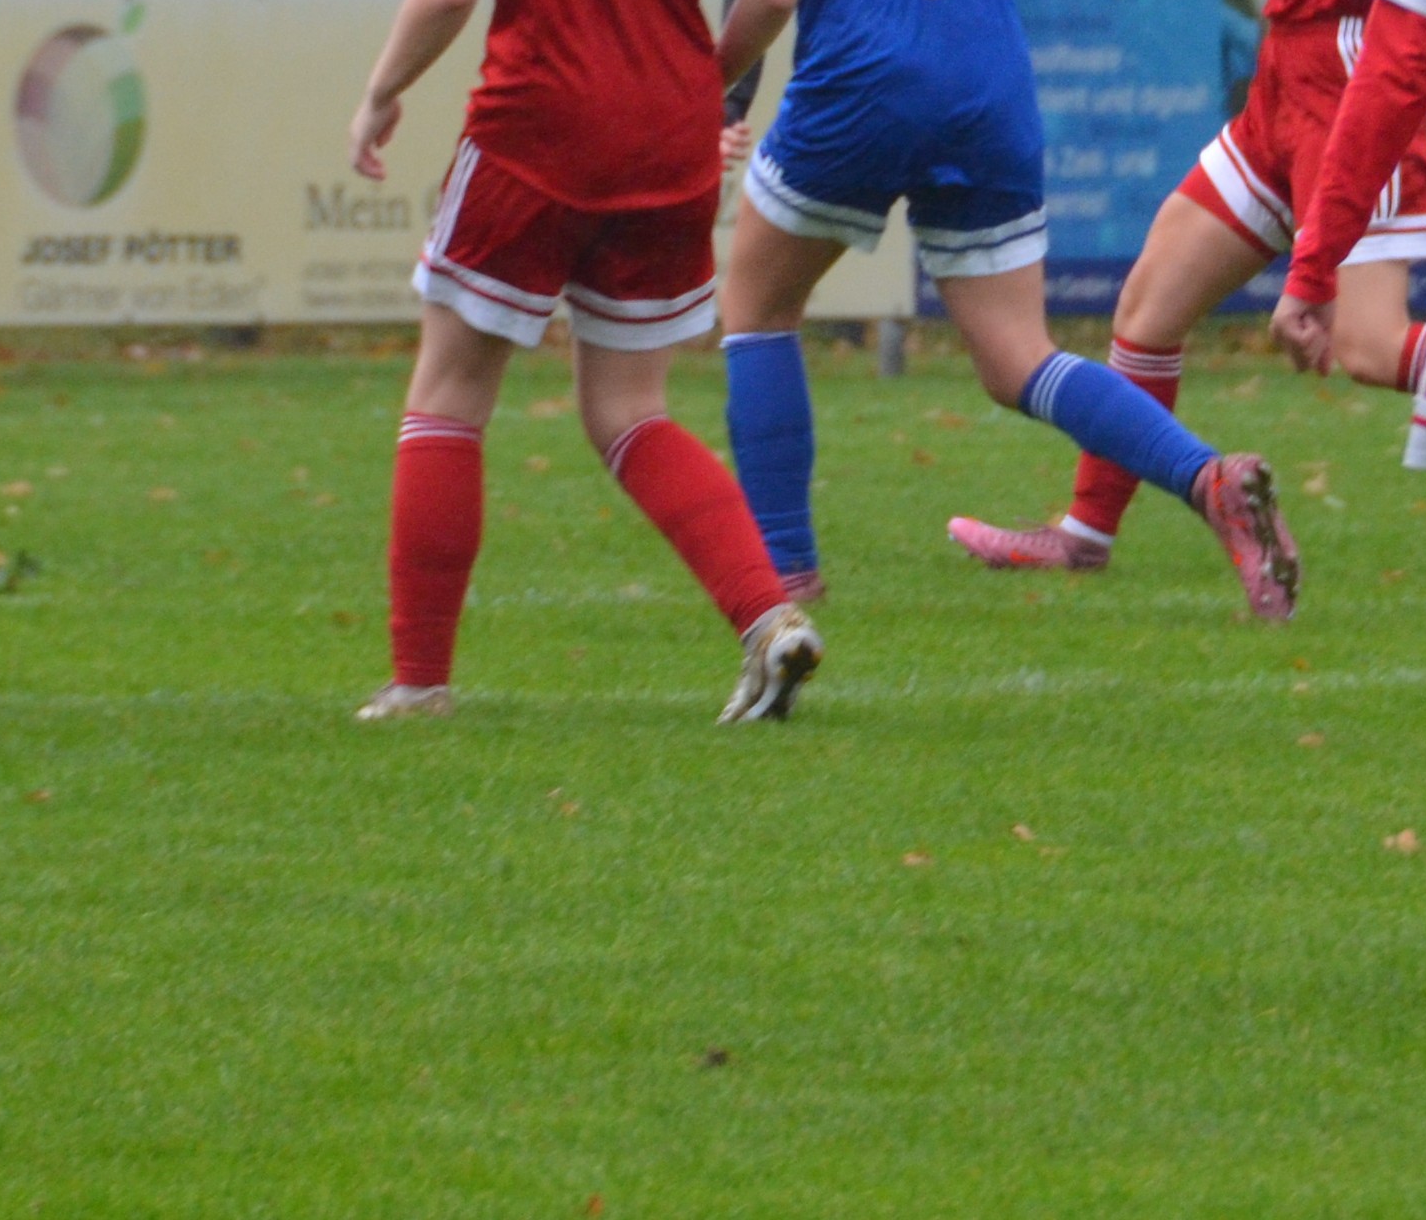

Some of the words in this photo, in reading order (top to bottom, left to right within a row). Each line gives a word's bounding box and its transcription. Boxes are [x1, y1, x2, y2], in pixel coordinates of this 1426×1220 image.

[305, 184, 413, 231] Mein
[22, 233, 113, 265] JOSEF
[122, 228, 243, 265] PÖTTER
